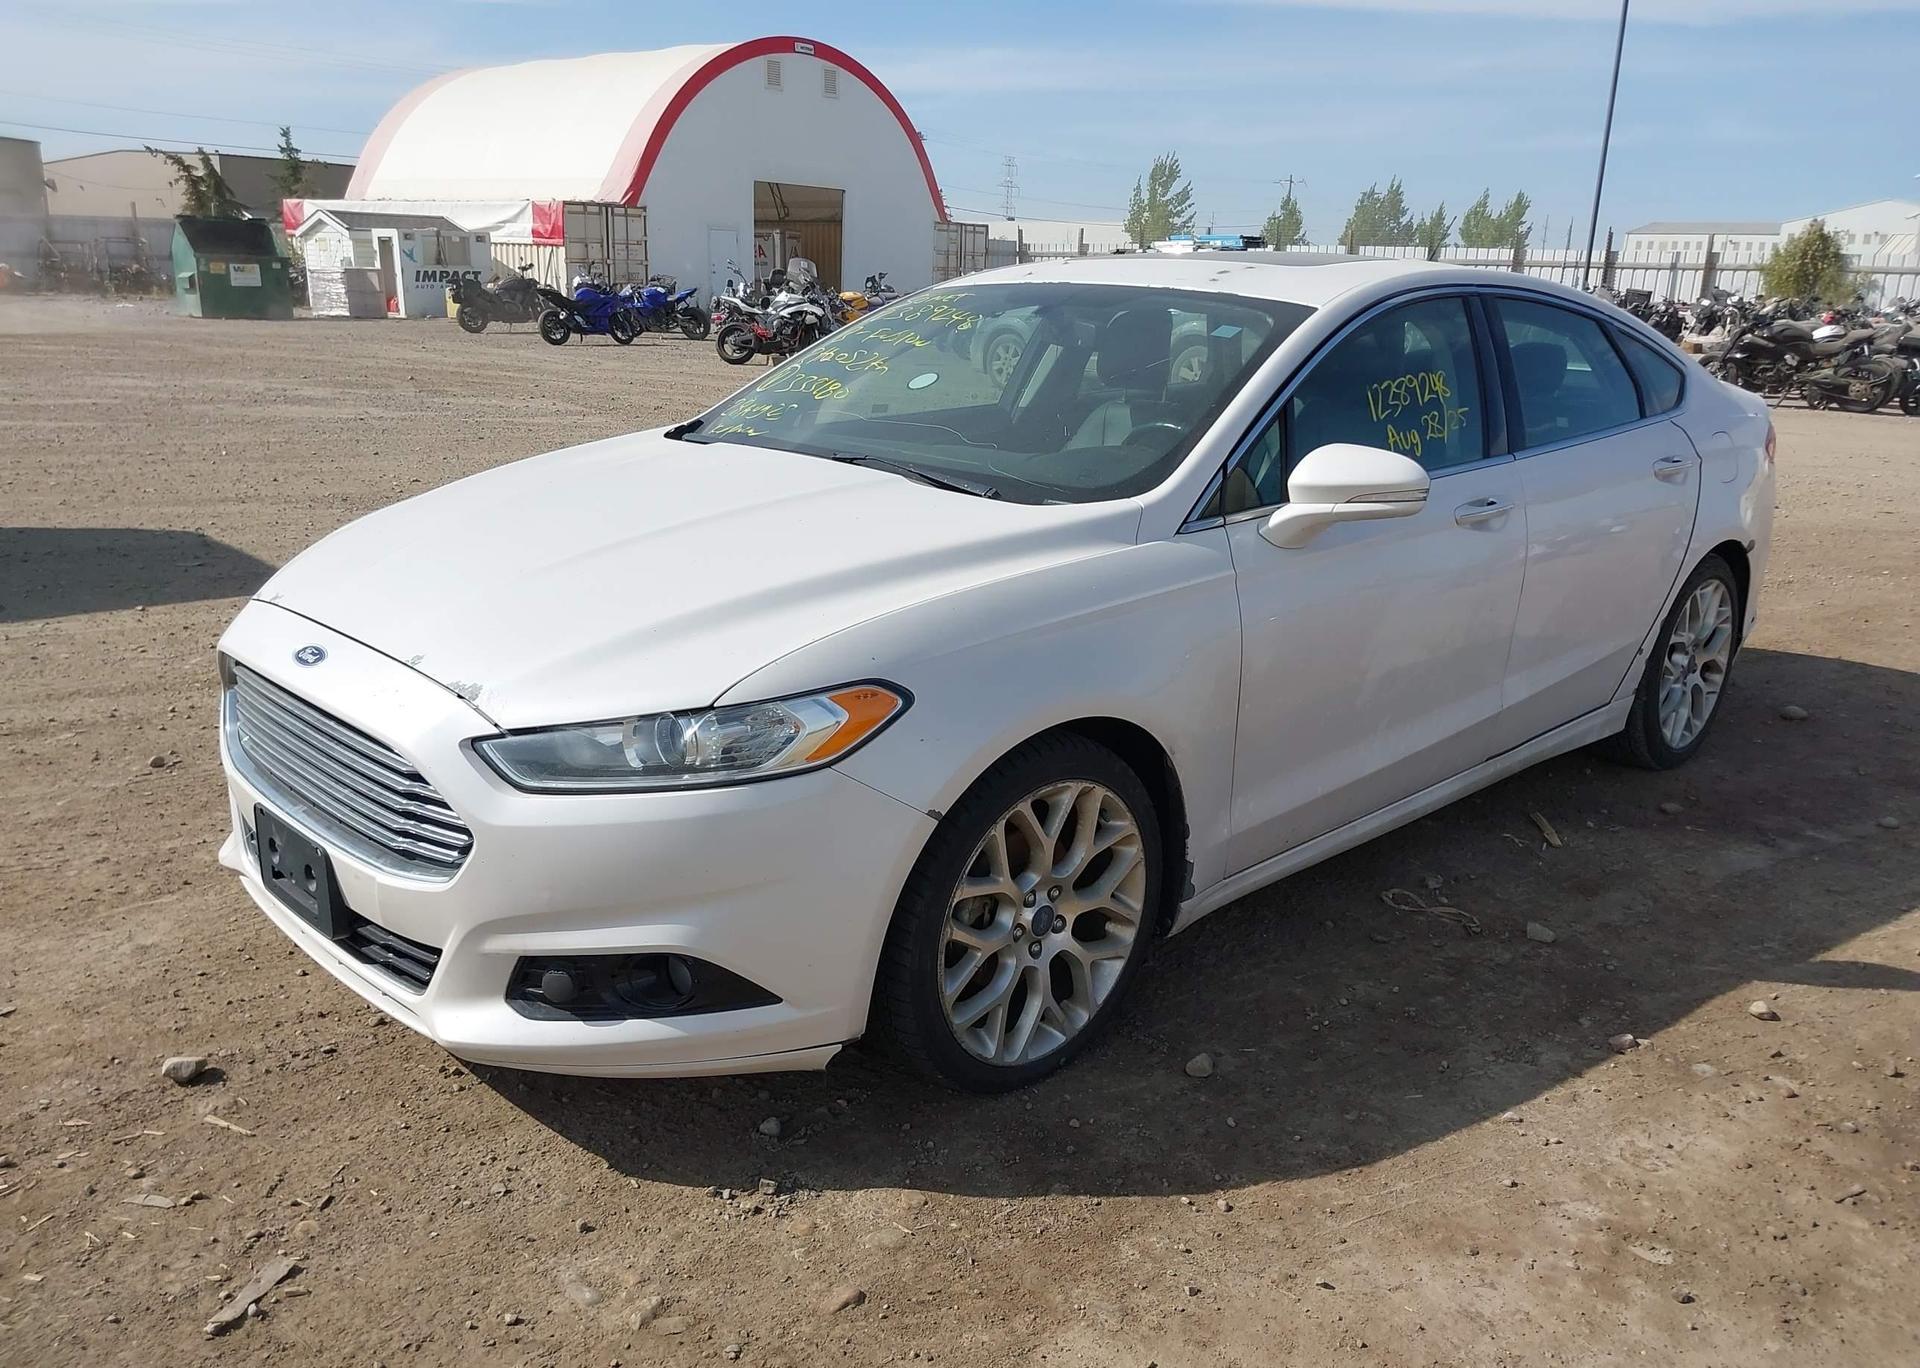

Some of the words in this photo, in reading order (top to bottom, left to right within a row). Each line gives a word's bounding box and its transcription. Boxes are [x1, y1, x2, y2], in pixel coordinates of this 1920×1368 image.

[415, 270, 481, 283] IMPACT
[1367, 370, 1451, 422] 12389248
[1386, 423, 1421, 457] Aug
